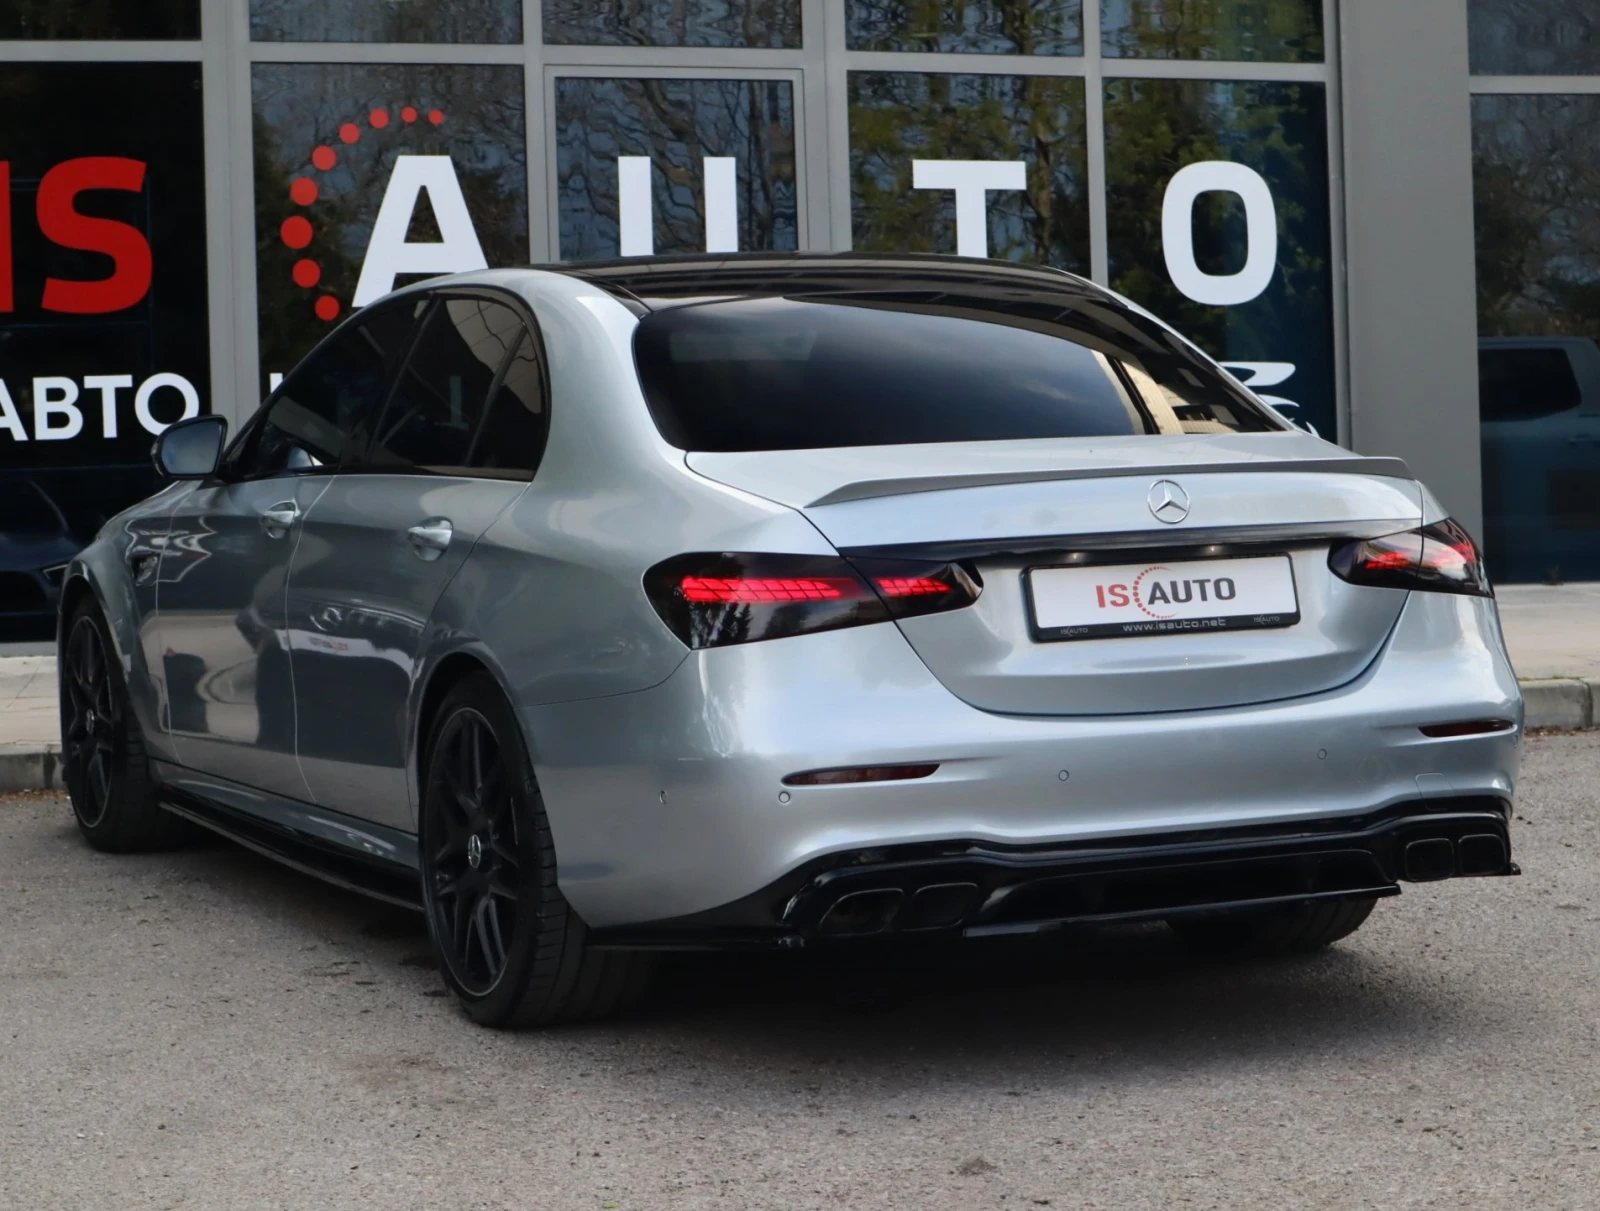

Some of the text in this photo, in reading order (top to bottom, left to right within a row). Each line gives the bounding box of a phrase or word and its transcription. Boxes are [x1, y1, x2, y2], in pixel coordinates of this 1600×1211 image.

[1095, 577, 1237, 609] IS AUTO
[1122, 618, 1227, 632] www.isauto.net
